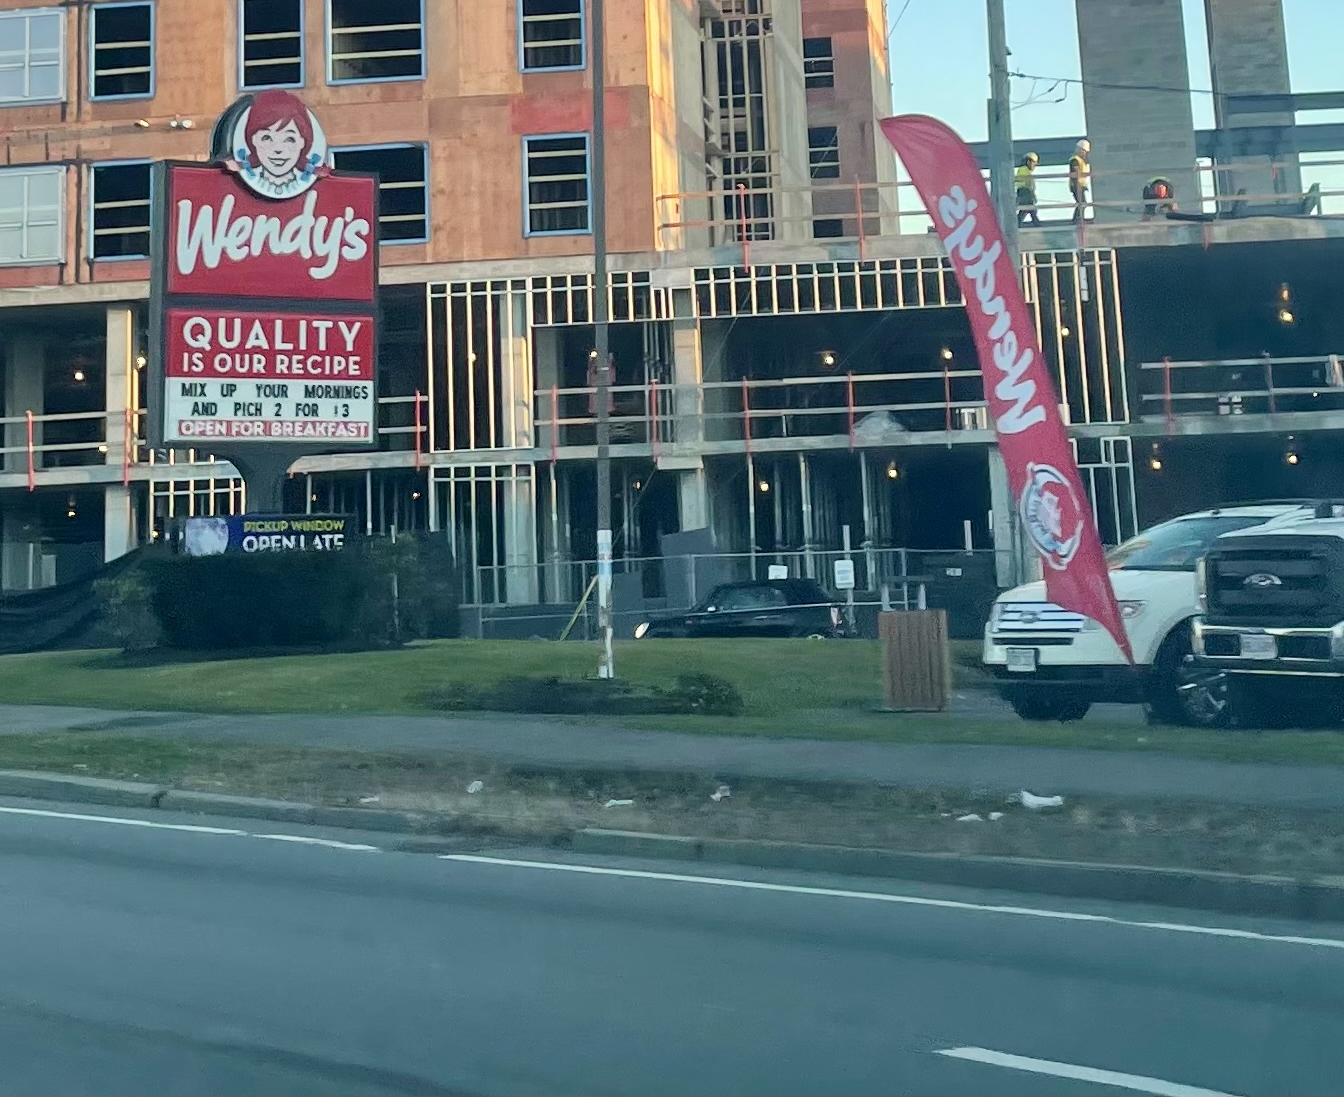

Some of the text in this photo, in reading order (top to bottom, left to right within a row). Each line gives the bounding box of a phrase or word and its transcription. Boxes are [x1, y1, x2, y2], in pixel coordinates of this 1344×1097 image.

[176, 189, 370, 280] Wendy's
[182, 316, 362, 352] QUALITY
[182, 352, 362, 376] IS OUR RECIPE
[180, 382, 369, 400] MIX UP YOUR MORNINGS
[191, 401, 218, 417] AND
[274, 402, 282, 417] 2
[295, 403, 319, 418] FOR
[180, 421, 368, 438] OPEN FOR BREAKFAST
[243, 519, 345, 532] PICKUP WINDOW
[242, 534, 297, 553] OPEN
